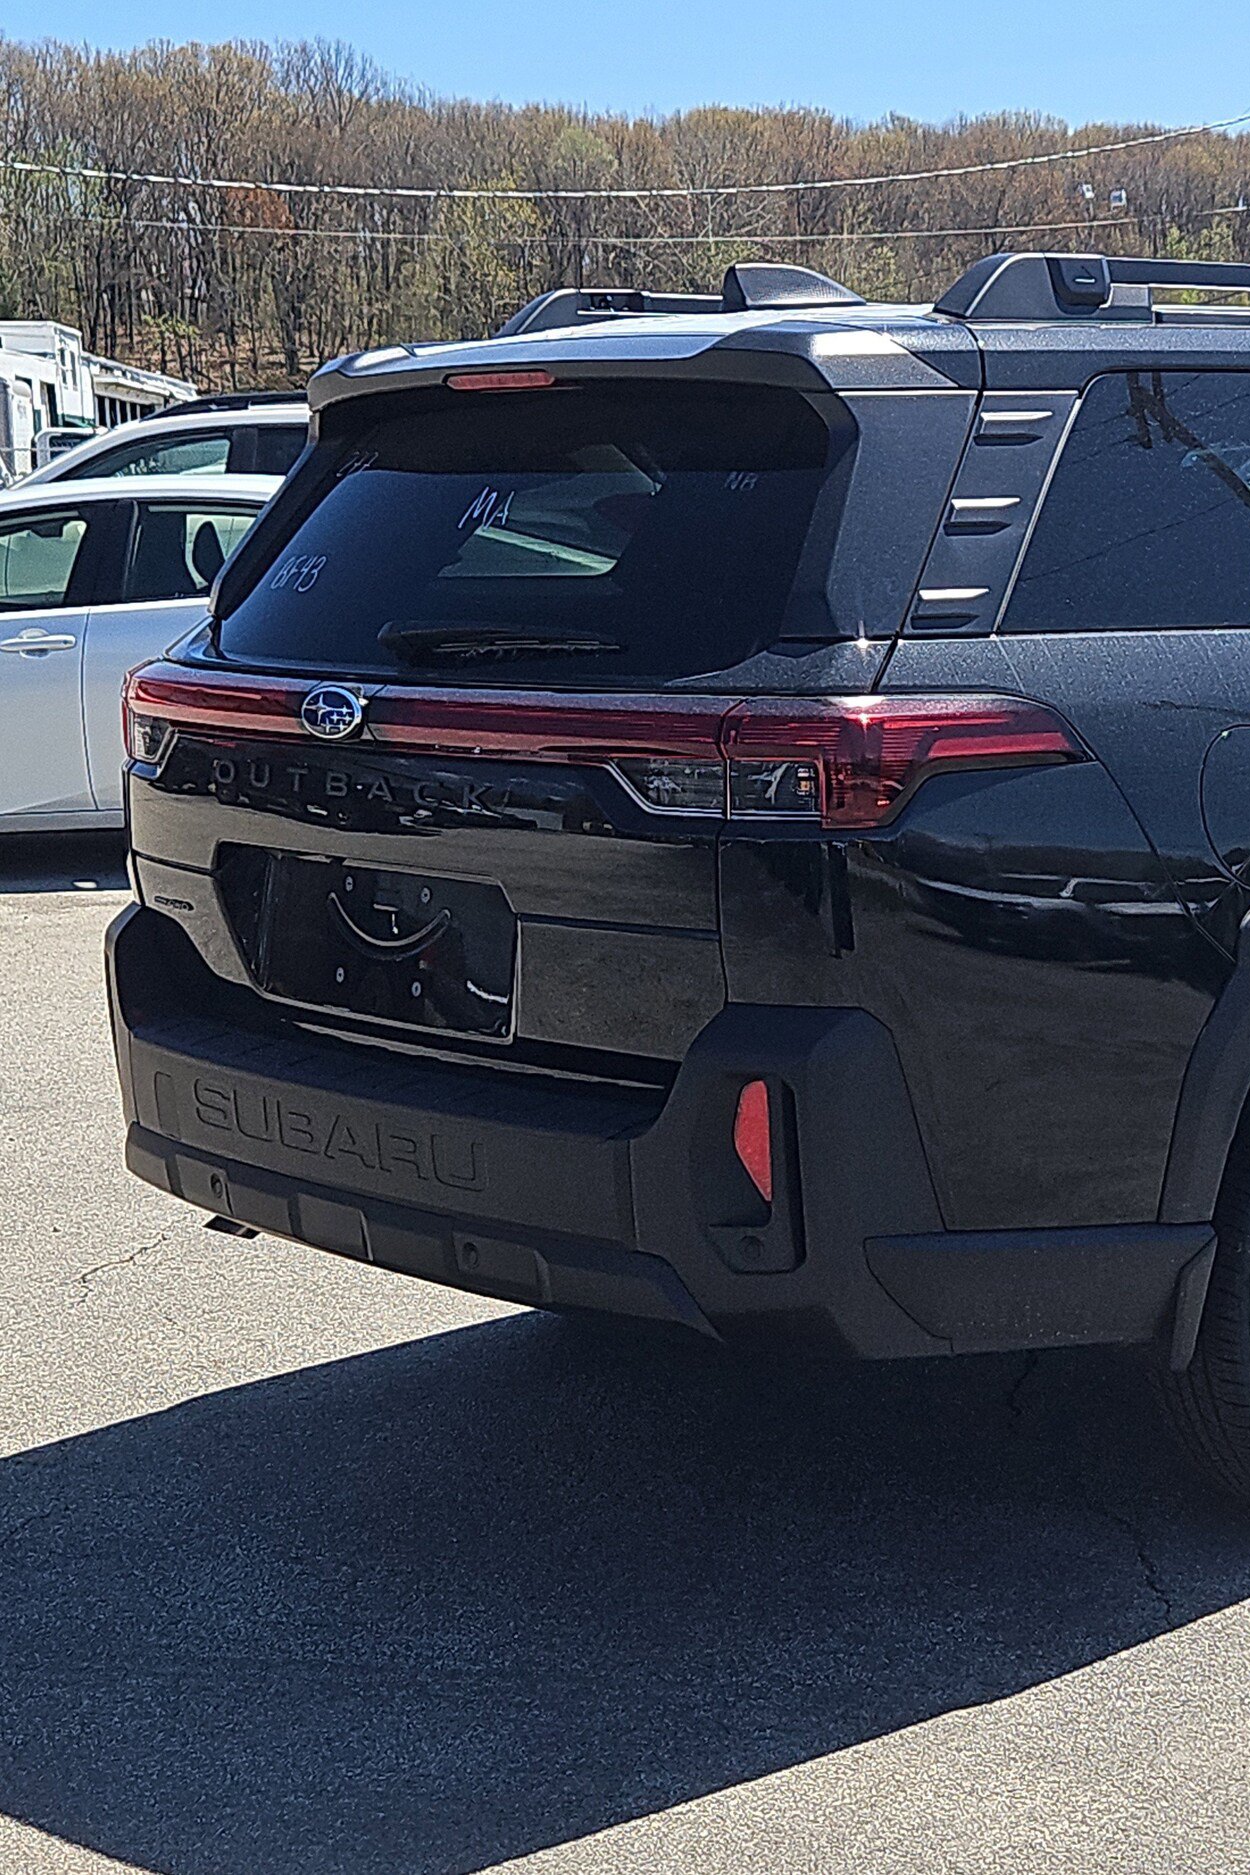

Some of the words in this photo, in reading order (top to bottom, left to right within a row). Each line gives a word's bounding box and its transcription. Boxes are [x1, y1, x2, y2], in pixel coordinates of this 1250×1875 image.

[458, 486, 516, 530] MA
[212, 758, 494, 812] OUTBACK
[194, 1077, 488, 1193] SUBARU
